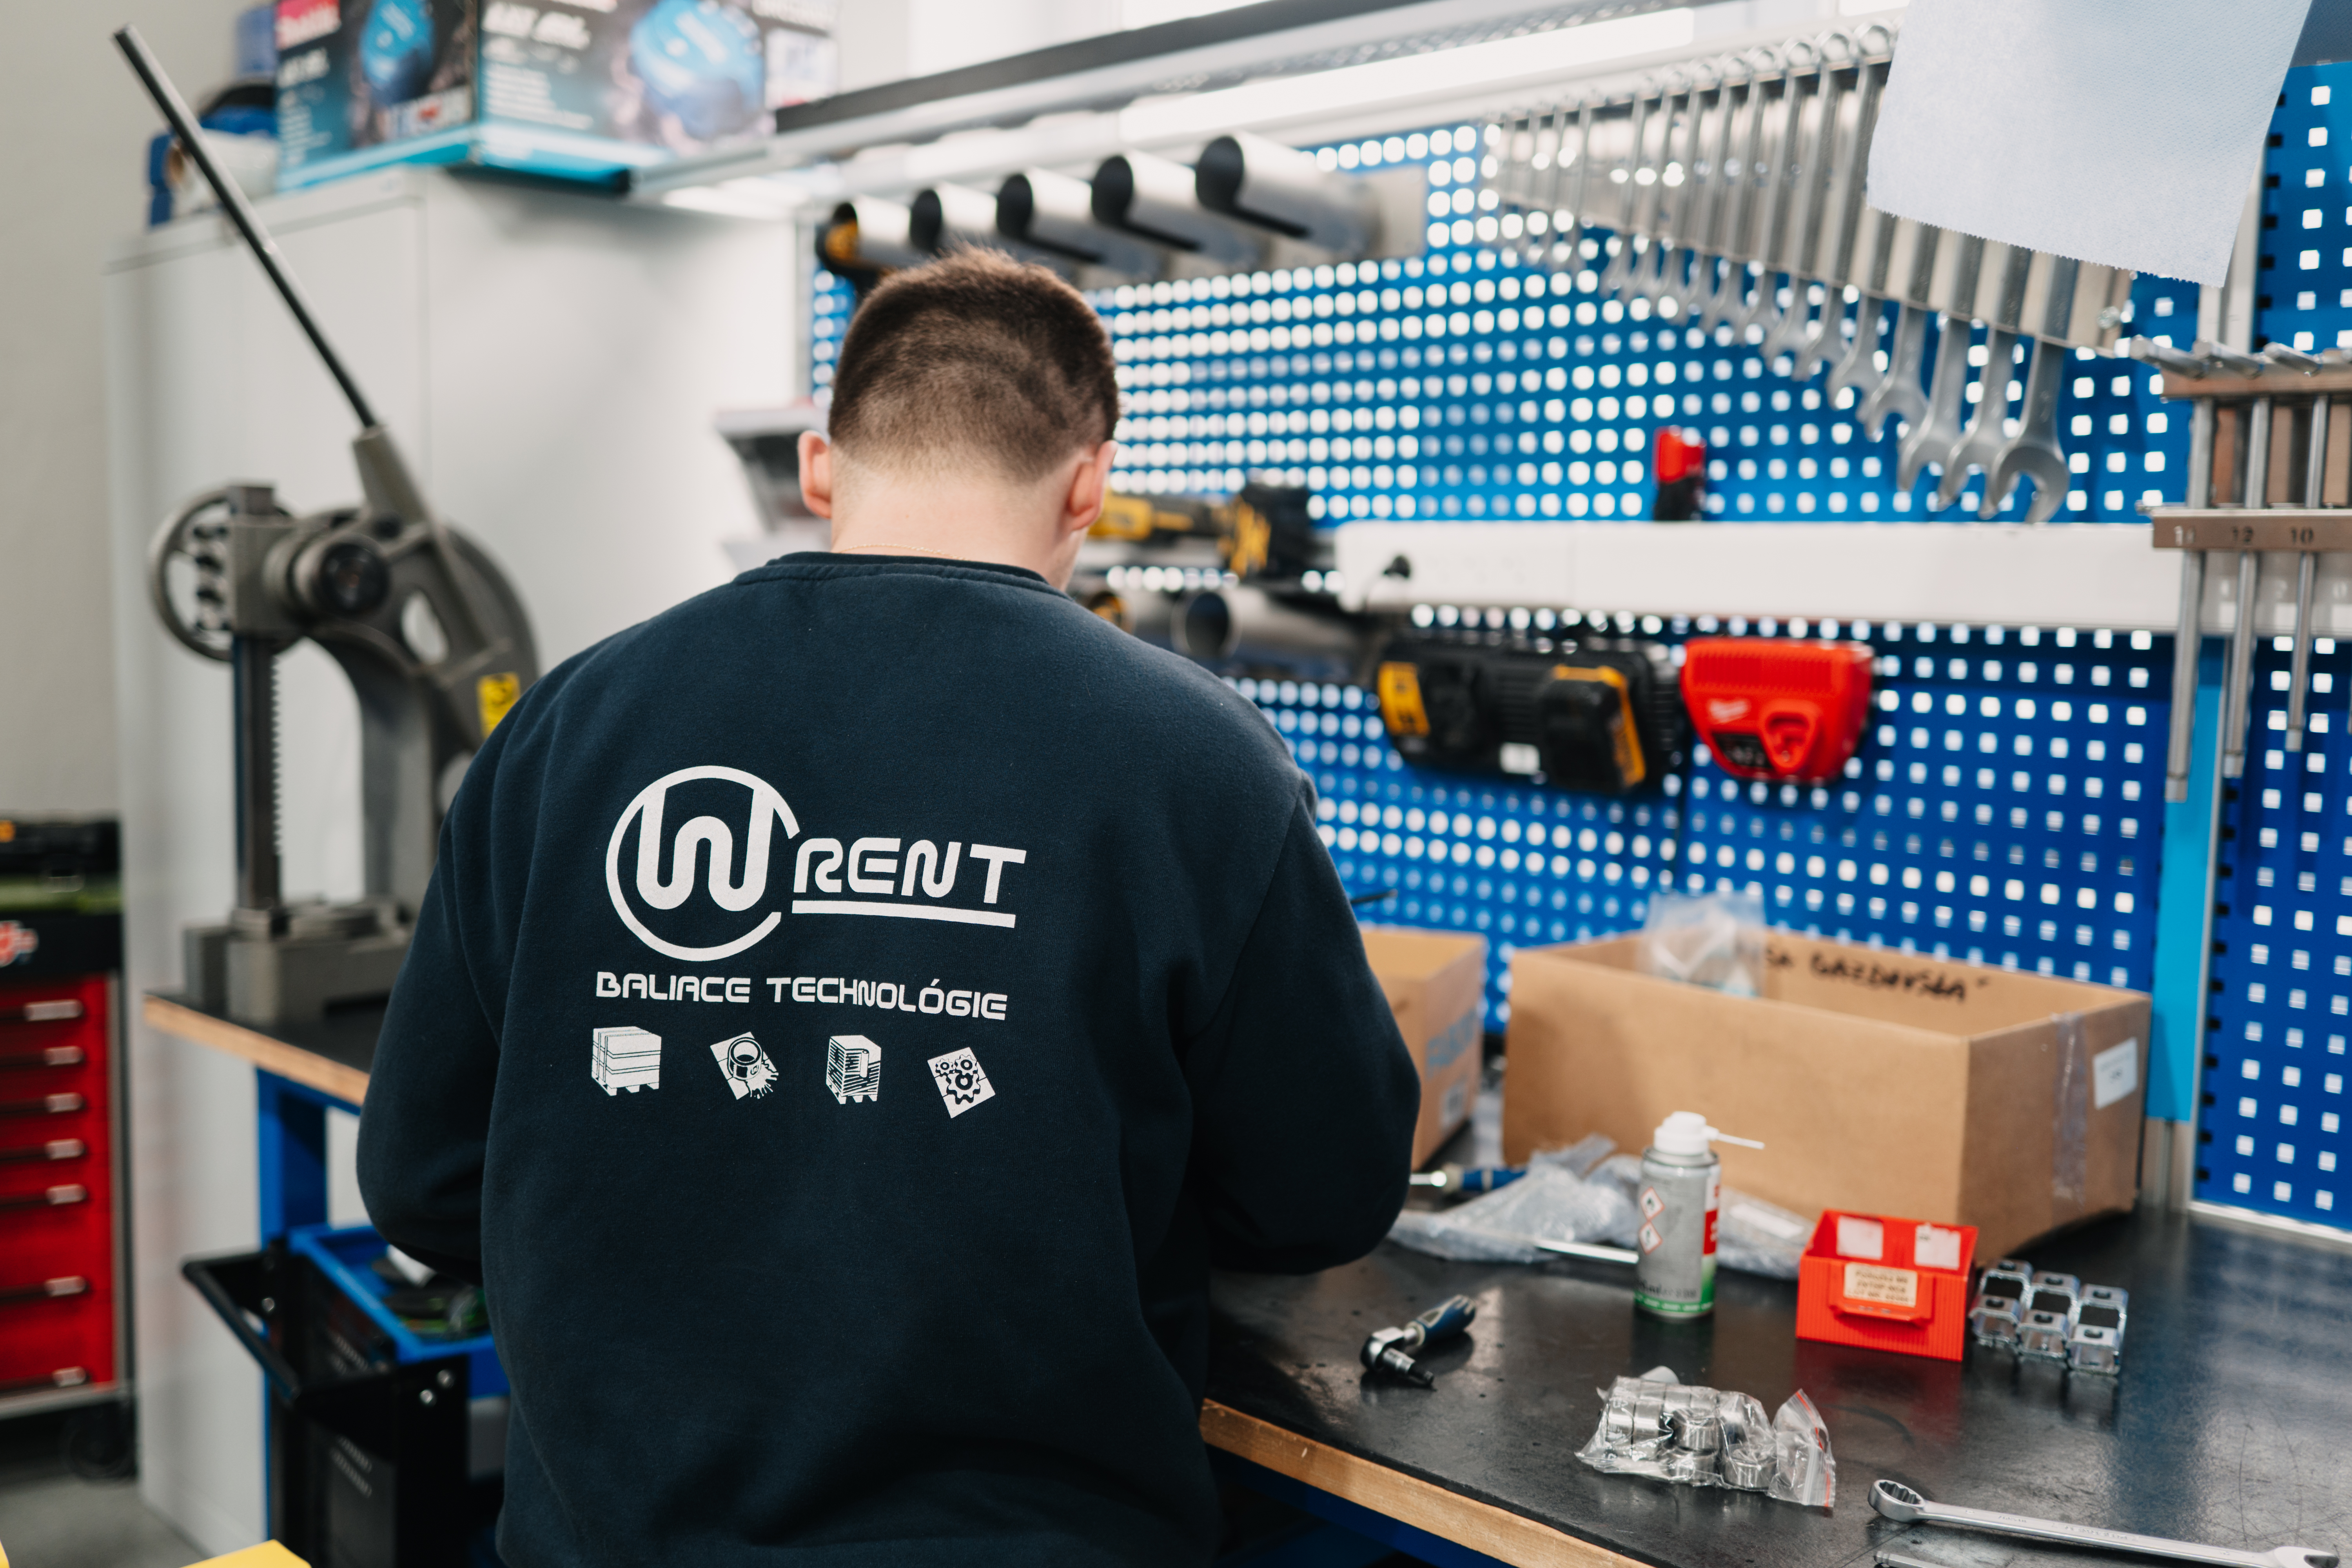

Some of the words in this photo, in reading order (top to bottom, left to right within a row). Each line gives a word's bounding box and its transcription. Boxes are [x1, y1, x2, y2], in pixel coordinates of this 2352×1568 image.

[2290, 527, 2314, 545] 10
[793, 837, 1027, 904] RENT
[596, 971, 751, 1003] BALIACE
[766, 977, 1008, 1020] TECHNOLÓGIE
